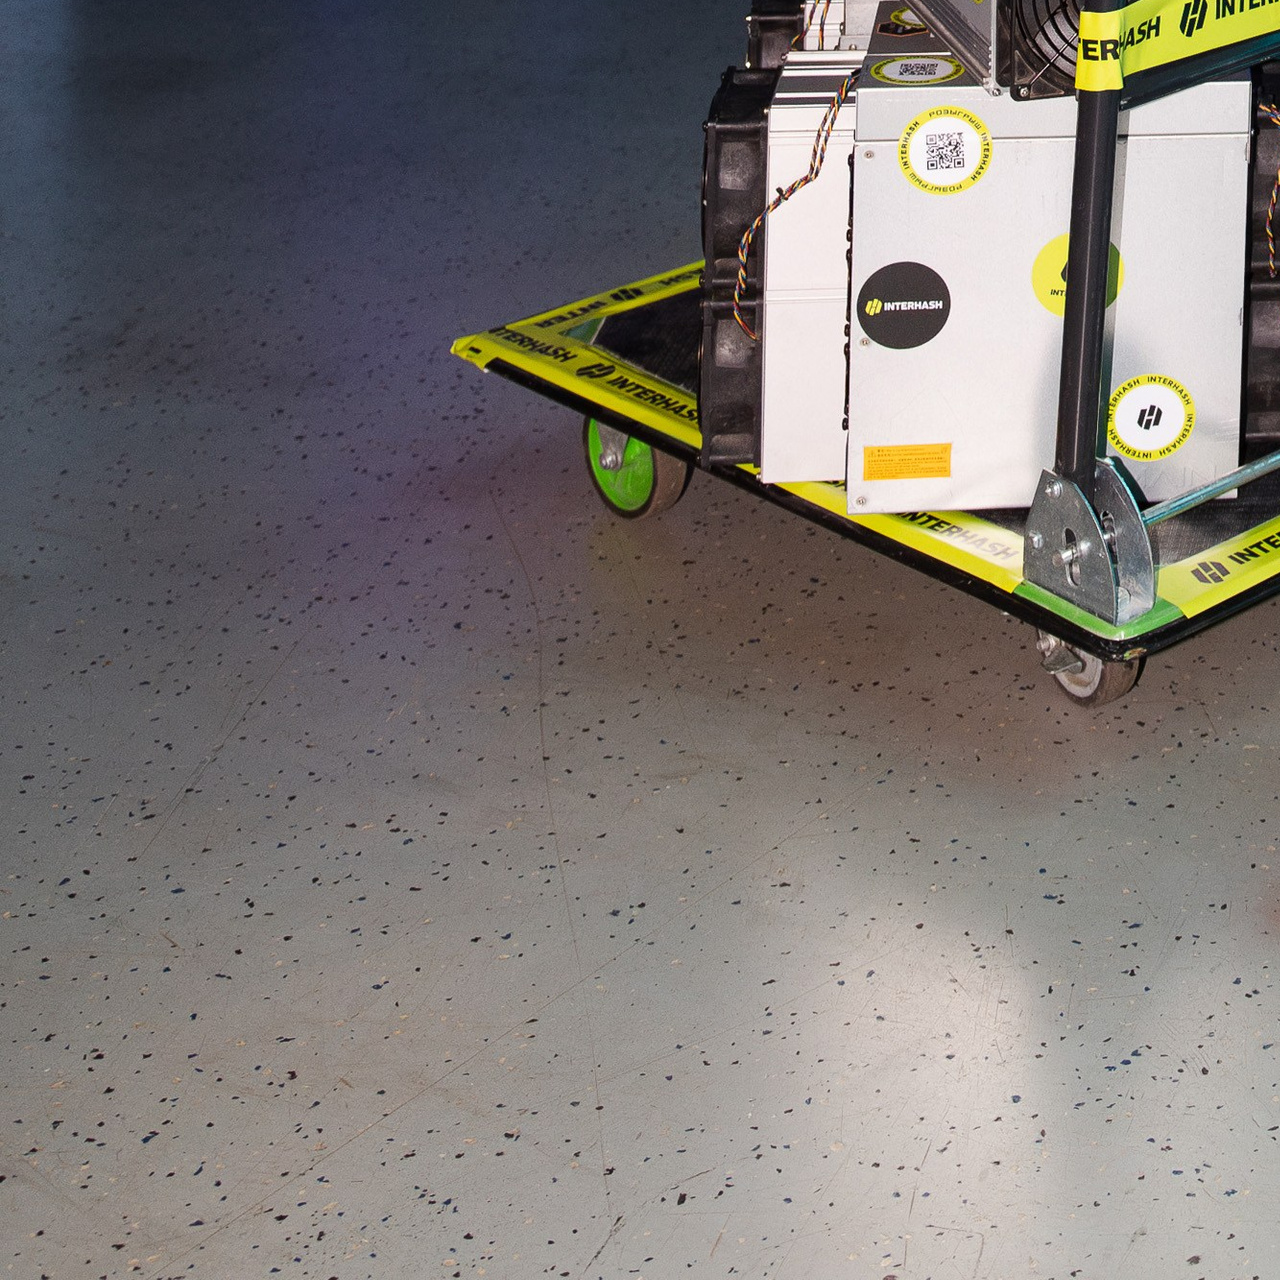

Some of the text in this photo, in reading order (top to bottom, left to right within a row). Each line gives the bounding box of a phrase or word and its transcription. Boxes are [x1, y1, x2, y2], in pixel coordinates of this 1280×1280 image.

[928, 108, 982, 131] РОЗЫГРЫШ
[900, 120, 920, 171] INTERHASH
[970, 132, 990, 181] INTERHASH
[884, 299, 943, 312] INTERHASH
[1107, 377, 1140, 422] INTERHASH
[1147, 376, 1191, 406] INTERHASH
[1108, 428, 1152, 459] INTERHASH
[1159, 413, 1193, 457] INTERHASH
